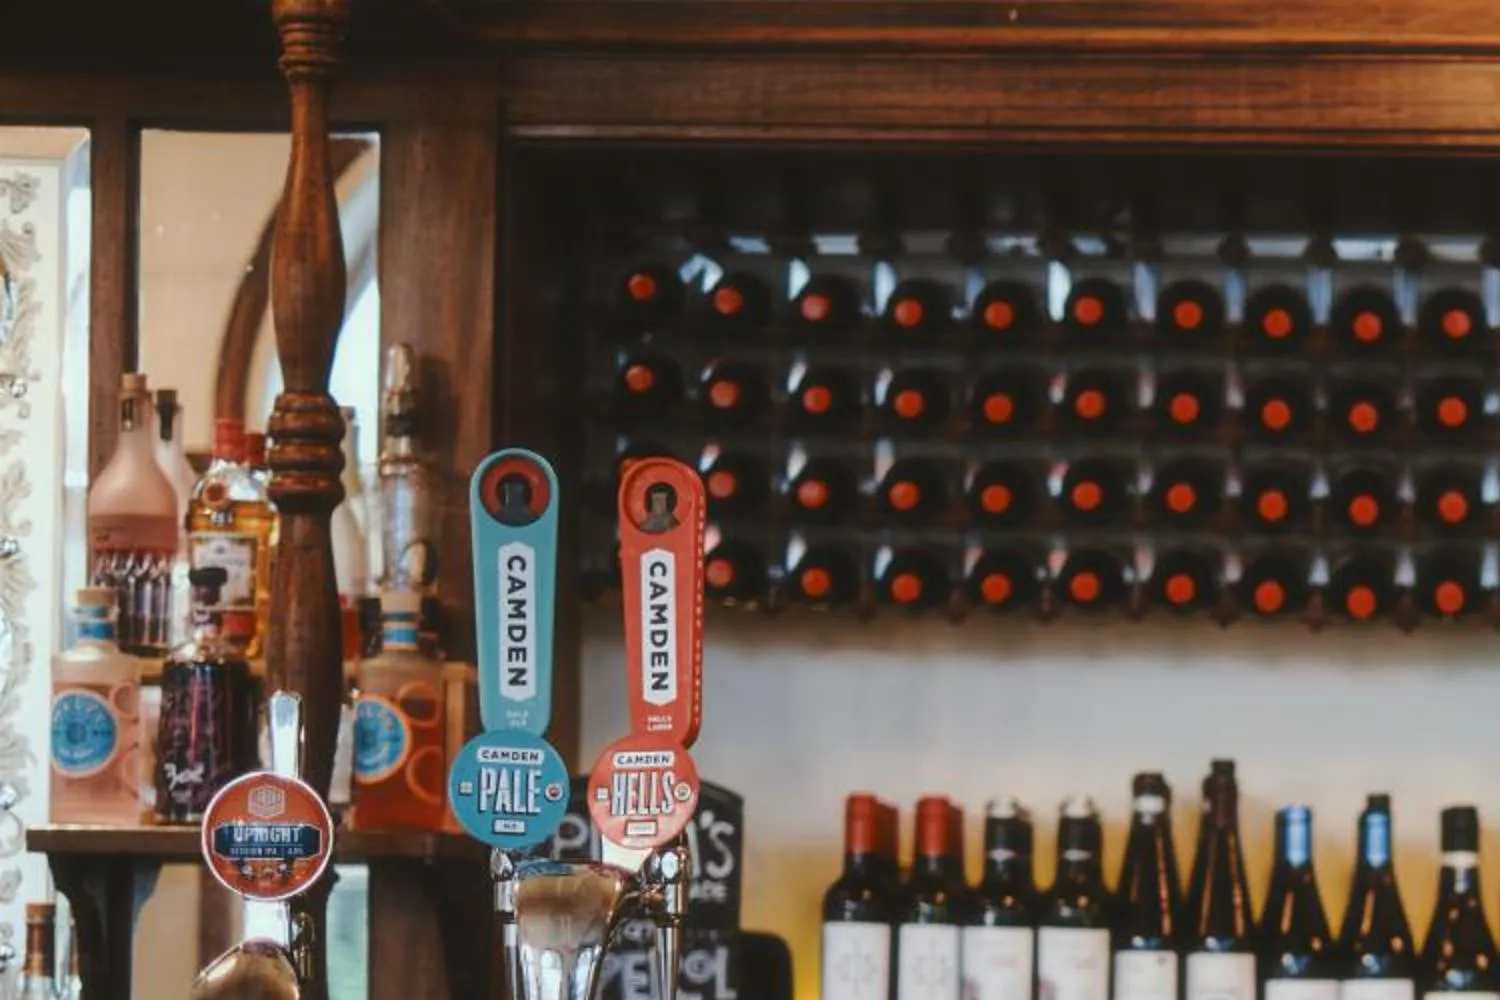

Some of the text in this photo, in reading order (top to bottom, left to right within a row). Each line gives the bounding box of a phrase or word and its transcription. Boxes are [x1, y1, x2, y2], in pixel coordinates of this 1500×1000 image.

[506, 555, 528, 687] CAMDEN
[648, 561, 670, 690] CAMDEN
[481, 749, 540, 761] CAMDEN
[617, 754, 670, 765] CAMDEN
[479, 766, 542, 815] PALE
[611, 771, 675, 816] HELLS
